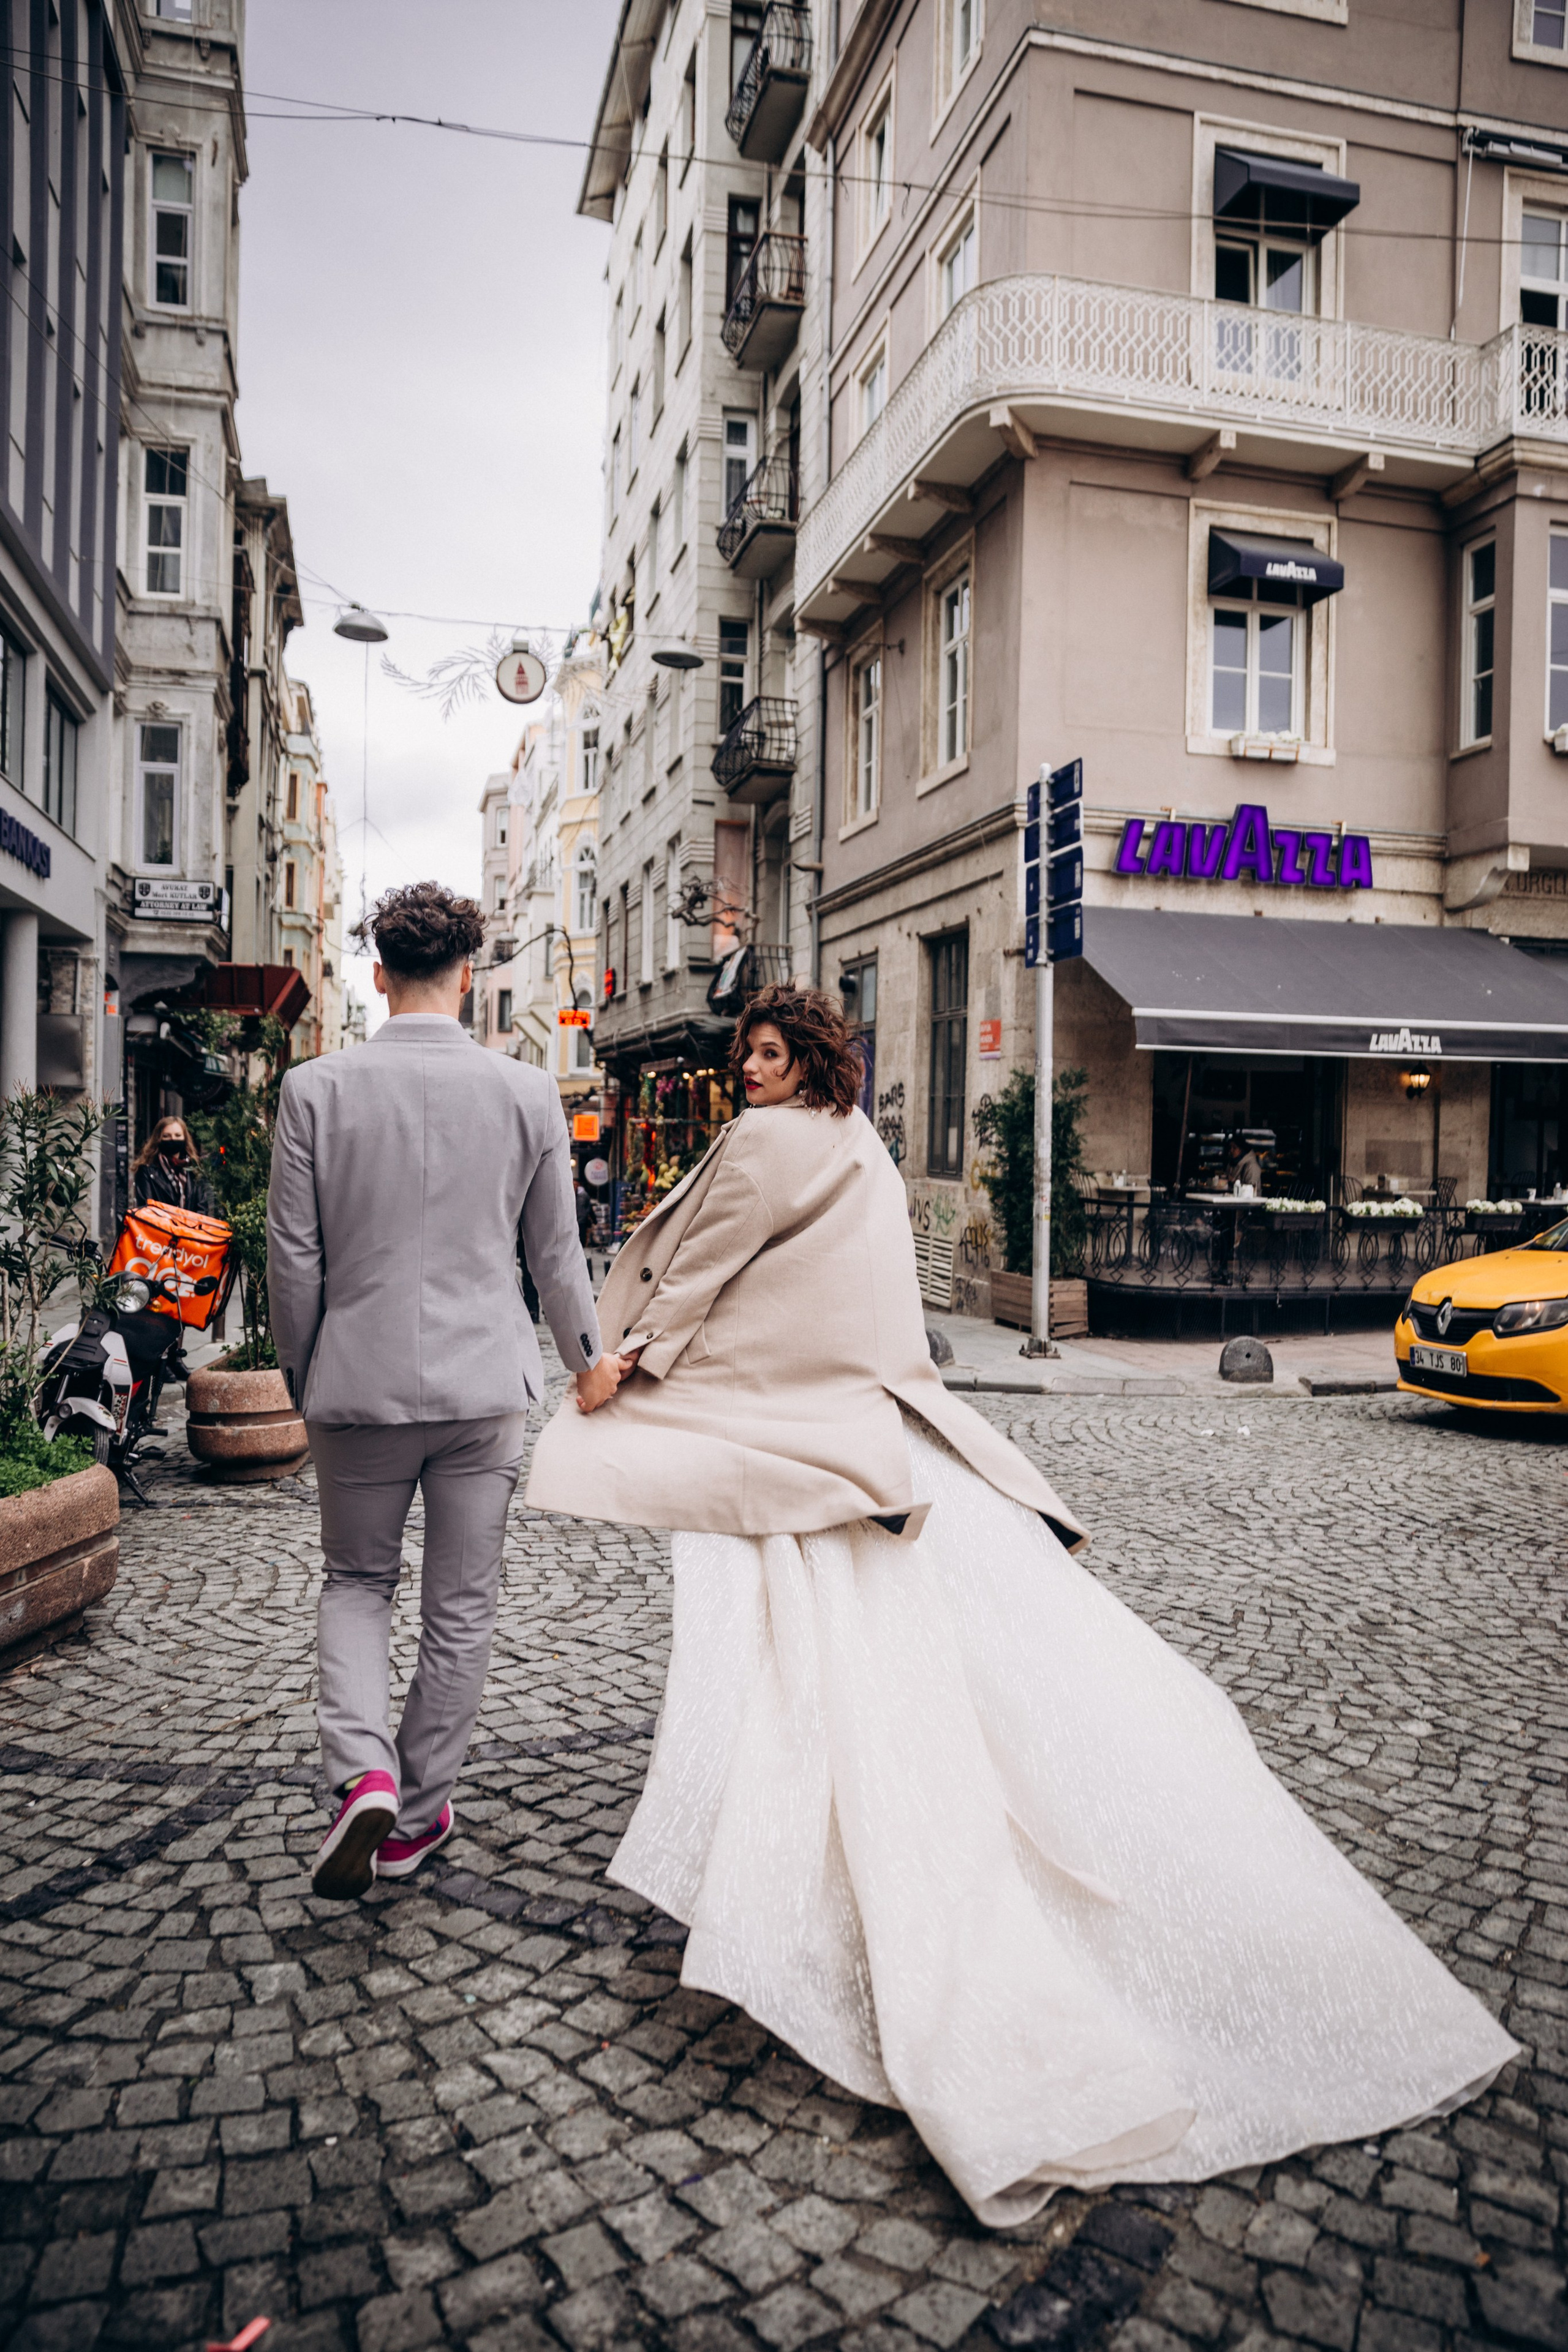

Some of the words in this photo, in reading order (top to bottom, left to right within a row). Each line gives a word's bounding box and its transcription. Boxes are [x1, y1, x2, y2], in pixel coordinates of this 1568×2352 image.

[1265, 560, 1316, 581] LAVAZZA
[1112, 804, 1373, 889] LAVAZZA
[140, 900, 179, 909] ATTORNEY
[1369, 1028, 1442, 1054] LAVAZZA
[135, 1234, 209, 1269] trendyol
[1415, 1350, 1424, 1365] 34
[1430, 1352, 1444, 1369] TJS
[1450, 1356, 1461, 1372] 80
